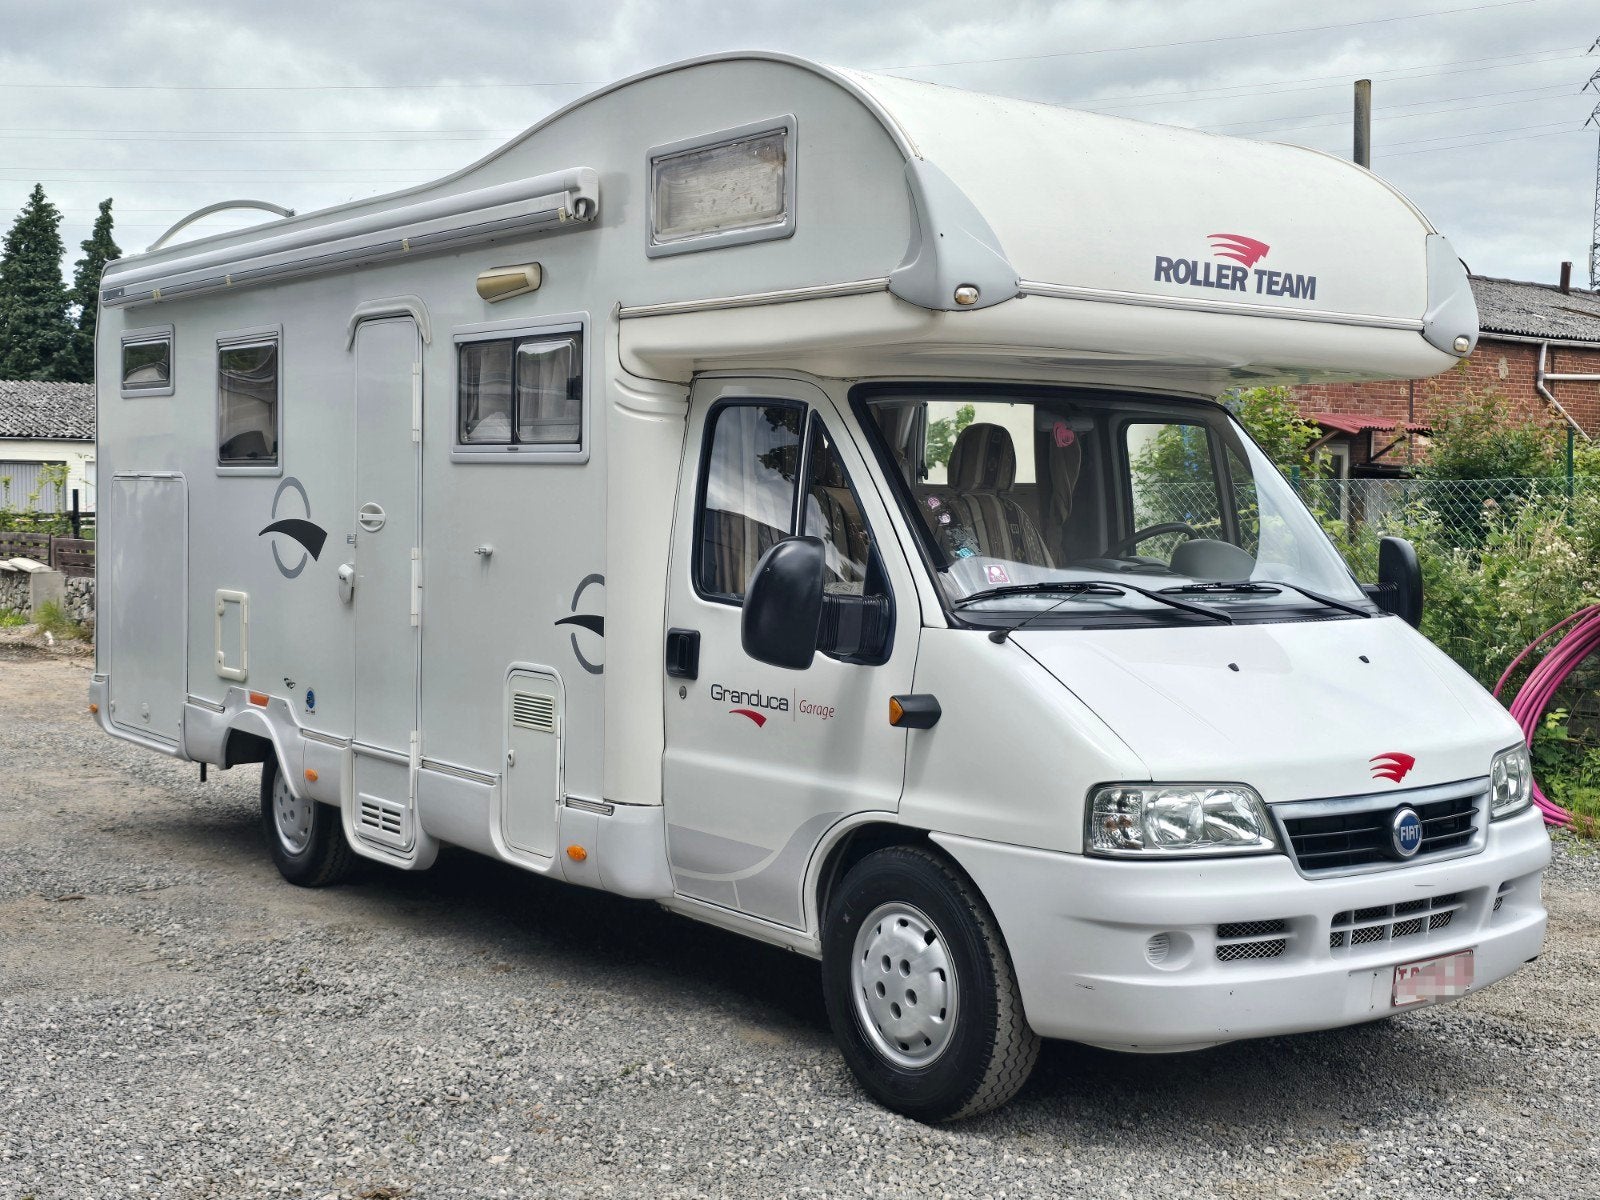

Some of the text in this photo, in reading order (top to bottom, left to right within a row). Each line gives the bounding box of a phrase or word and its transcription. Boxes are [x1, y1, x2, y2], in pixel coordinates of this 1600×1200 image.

[1154, 255, 1317, 300] ROLLER TEAM
[710, 683, 835, 720] Granduca Garage
[1400, 824, 1419, 842] FIAT
